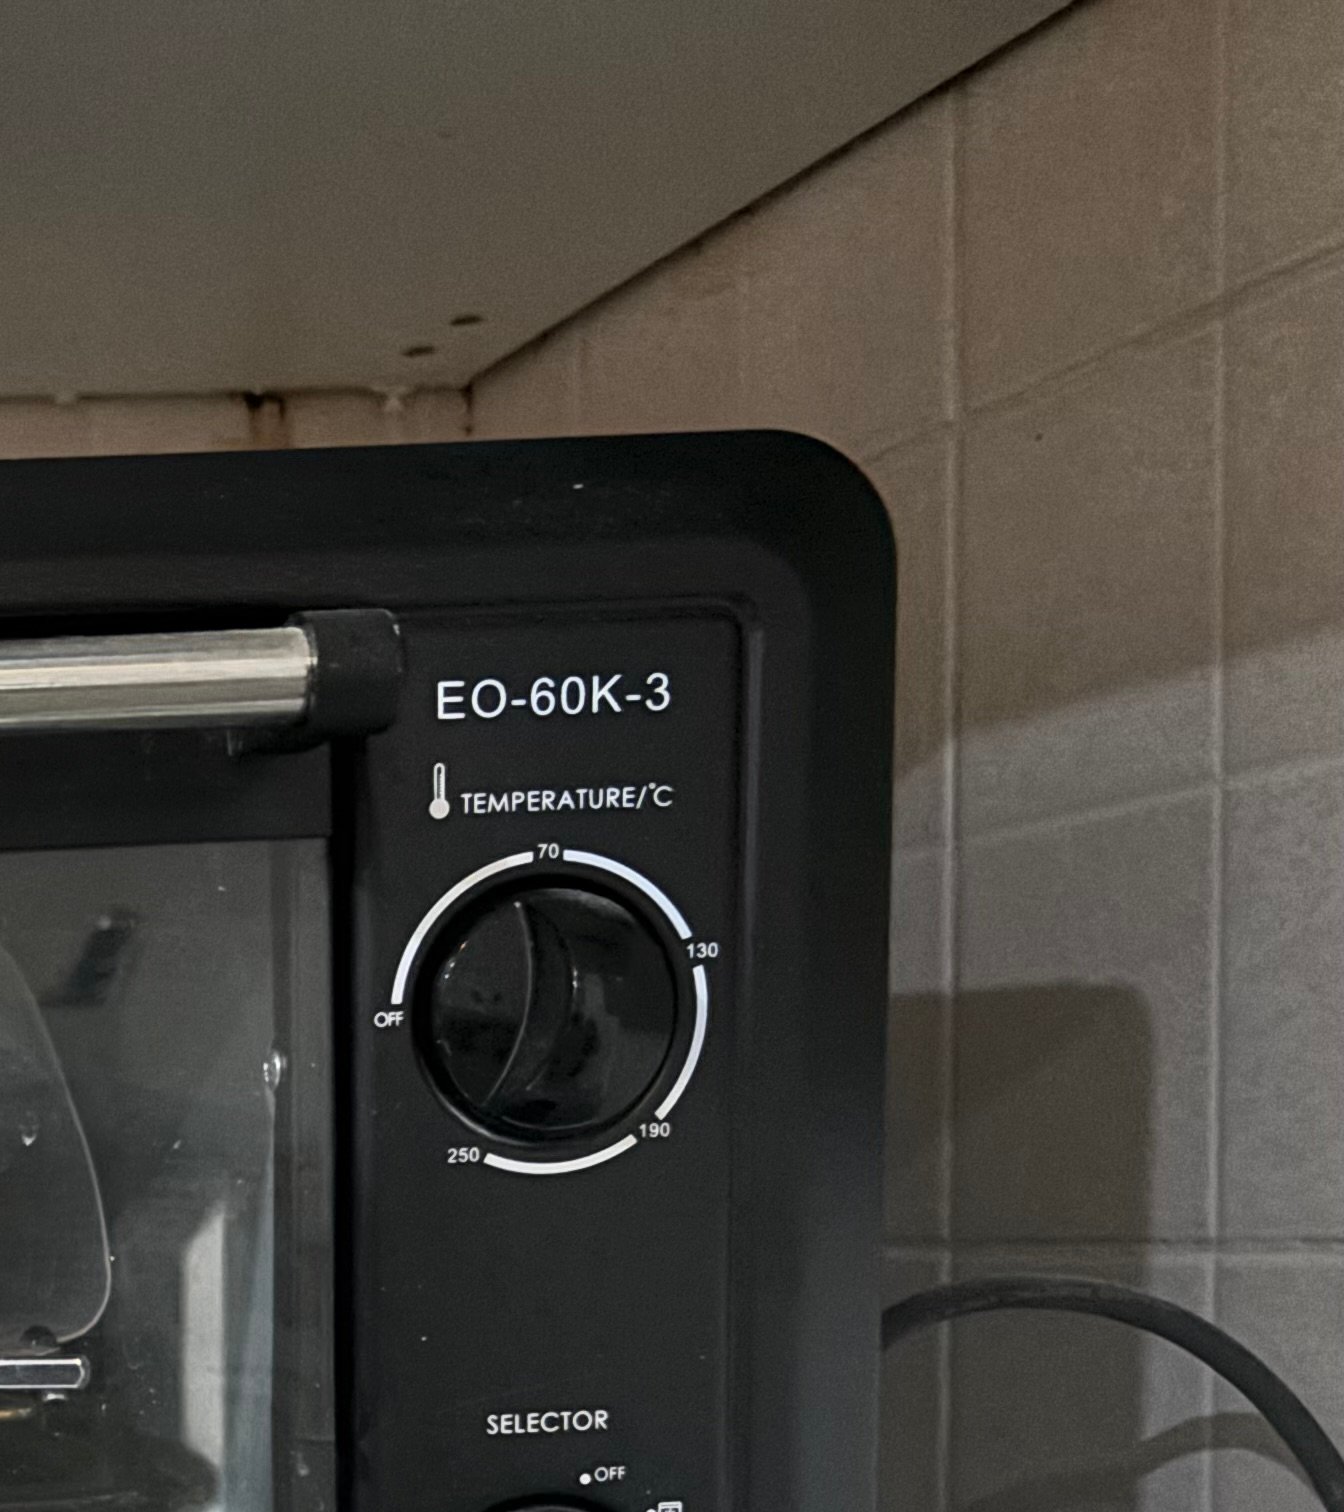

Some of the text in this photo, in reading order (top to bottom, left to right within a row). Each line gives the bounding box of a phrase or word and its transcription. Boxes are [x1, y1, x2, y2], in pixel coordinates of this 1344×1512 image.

[437, 672, 671, 720] EO-60K-3
[537, 843, 560, 859] 70
[687, 942, 719, 959] 130
[373, 1010, 404, 1028] OFF
[639, 1122, 671, 1138] 190
[447, 1146, 480, 1164] 250
[486, 1409, 609, 1435] SELECTOR
[594, 1465, 626, 1482] OFF
